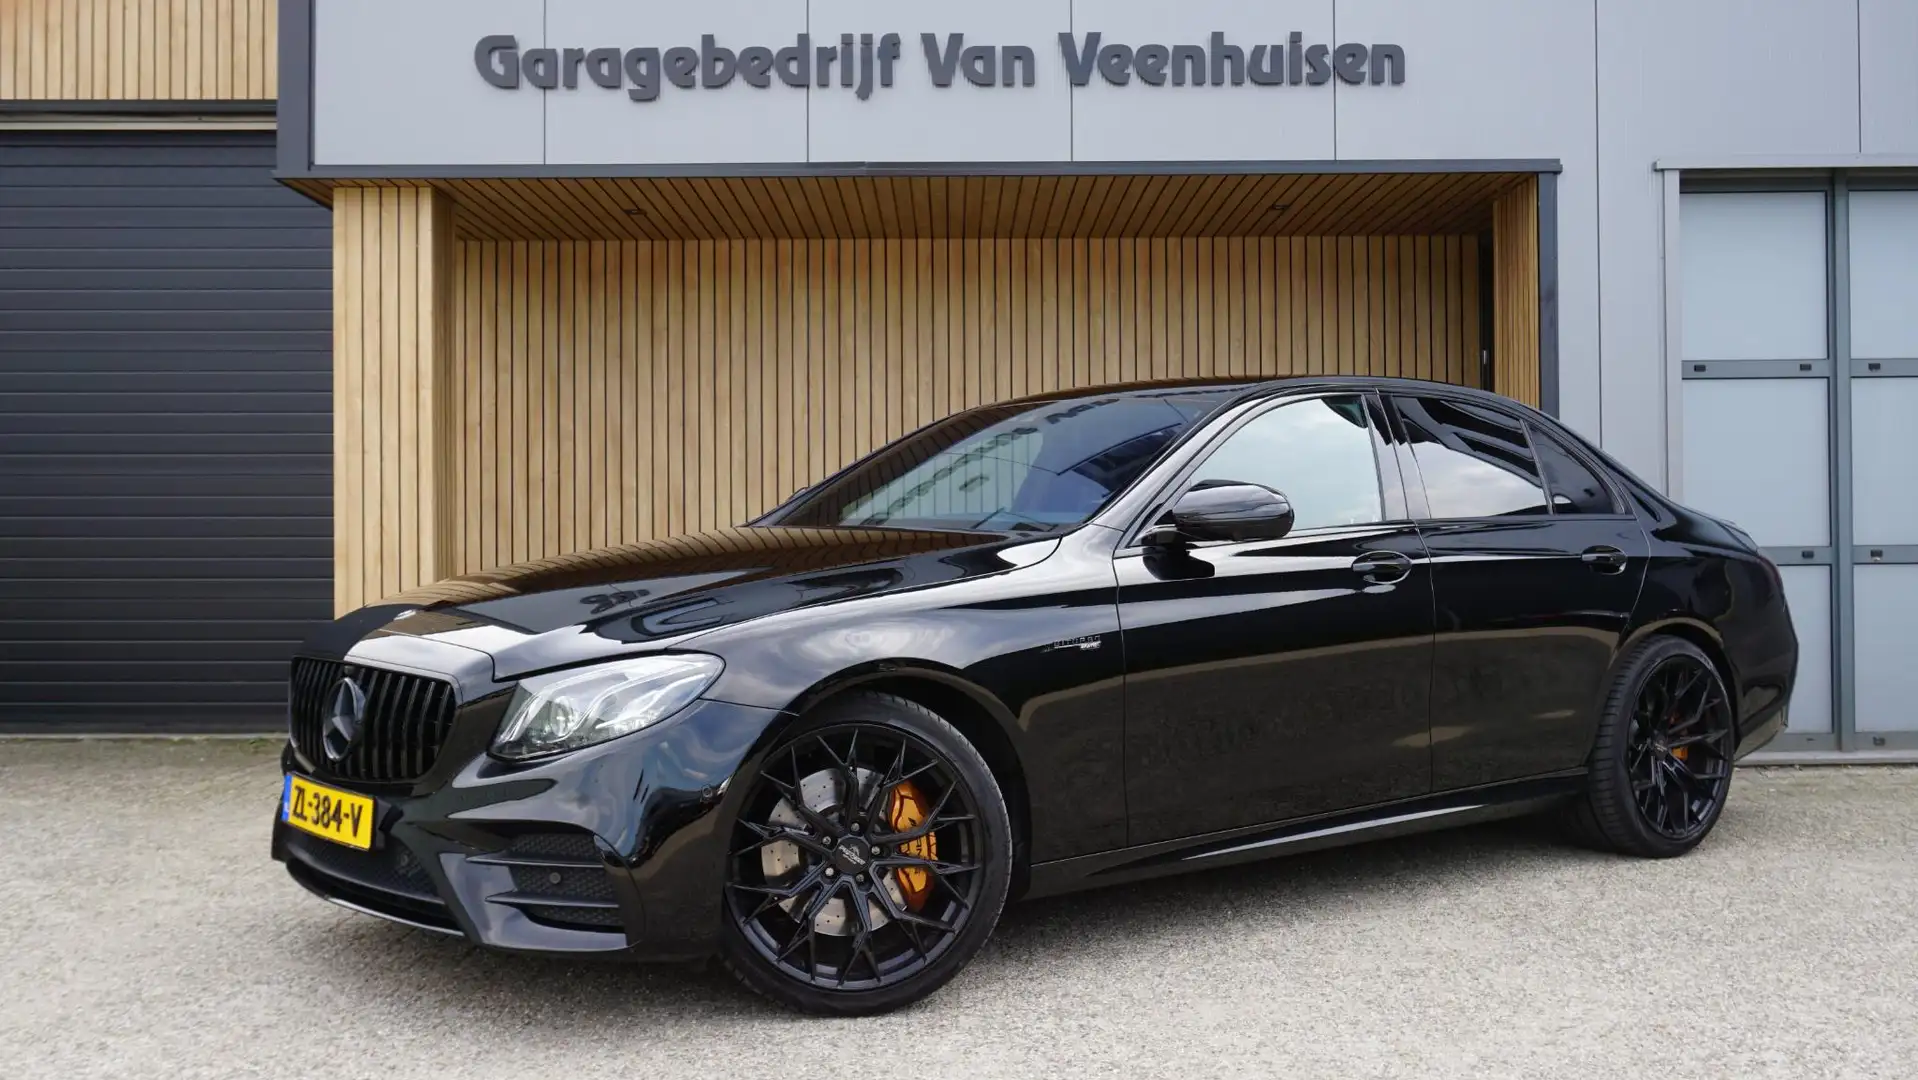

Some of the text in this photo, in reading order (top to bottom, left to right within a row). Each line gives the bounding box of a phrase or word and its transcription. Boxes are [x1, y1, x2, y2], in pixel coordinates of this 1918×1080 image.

[474, 31, 1405, 101] Garagebedrijf Van Veenhuisen
[292, 785, 363, 838] ZL-384-V
